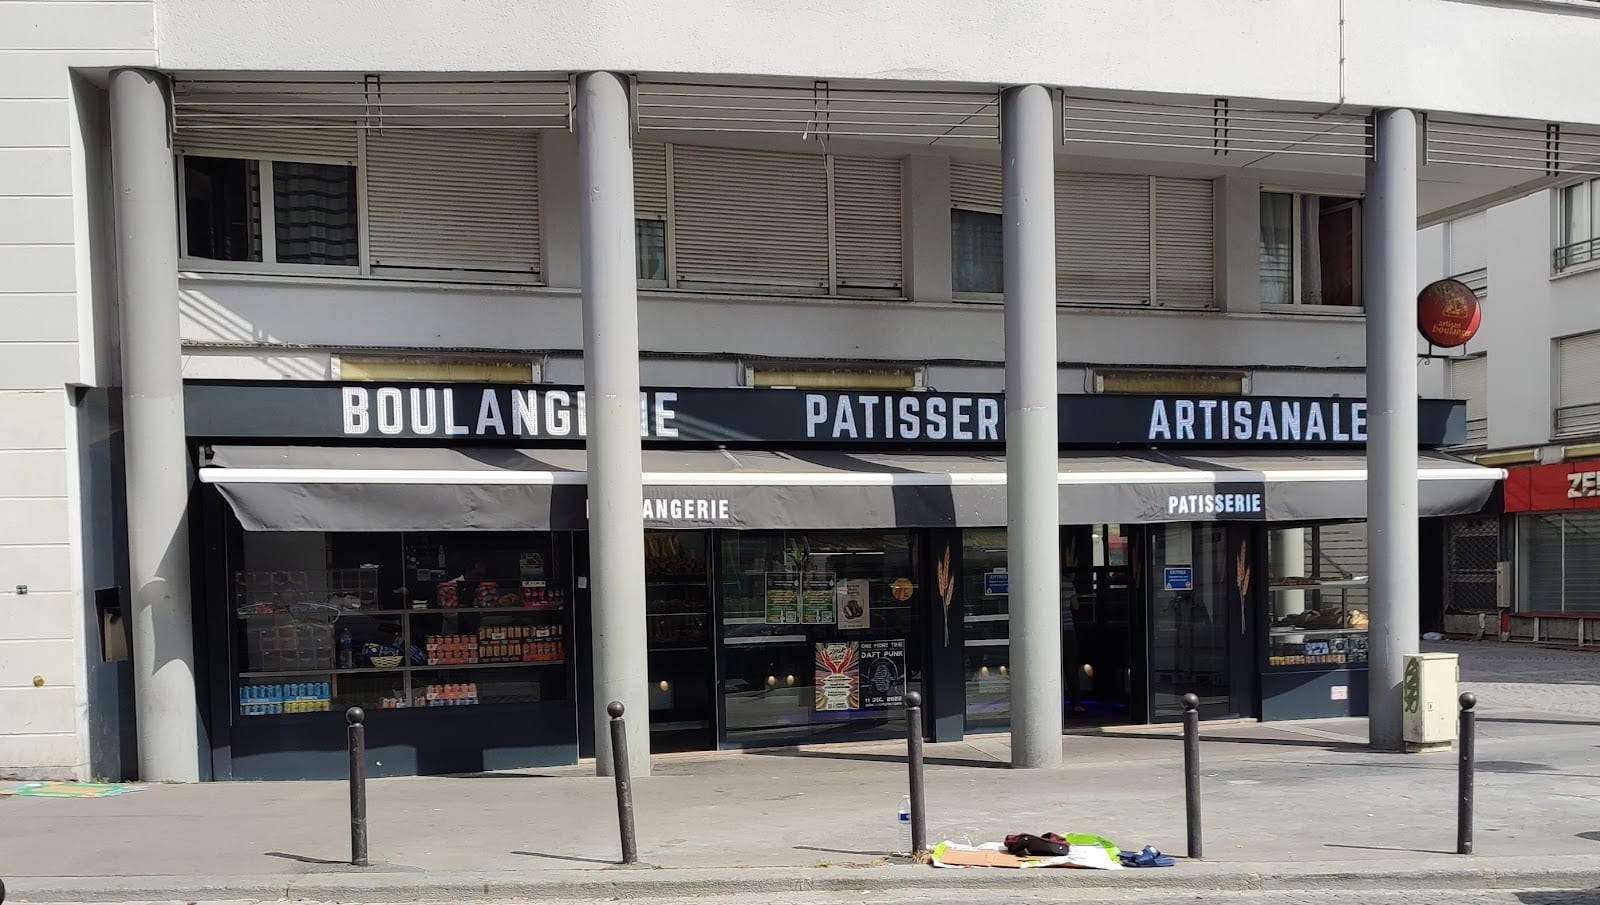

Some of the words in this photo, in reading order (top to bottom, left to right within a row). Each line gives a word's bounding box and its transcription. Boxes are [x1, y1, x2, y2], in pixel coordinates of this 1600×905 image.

[341, 386, 679, 438] BOULANGIE
[806, 394, 1006, 440] PATISSER
[1148, 400, 1368, 441] ARTISANALE
[1567, 470, 1600, 499] ZE
[1168, 494, 1261, 514] PATISSERIE
[861, 651, 881, 659] DAFT
[883, 649, 904, 657] PUNK
